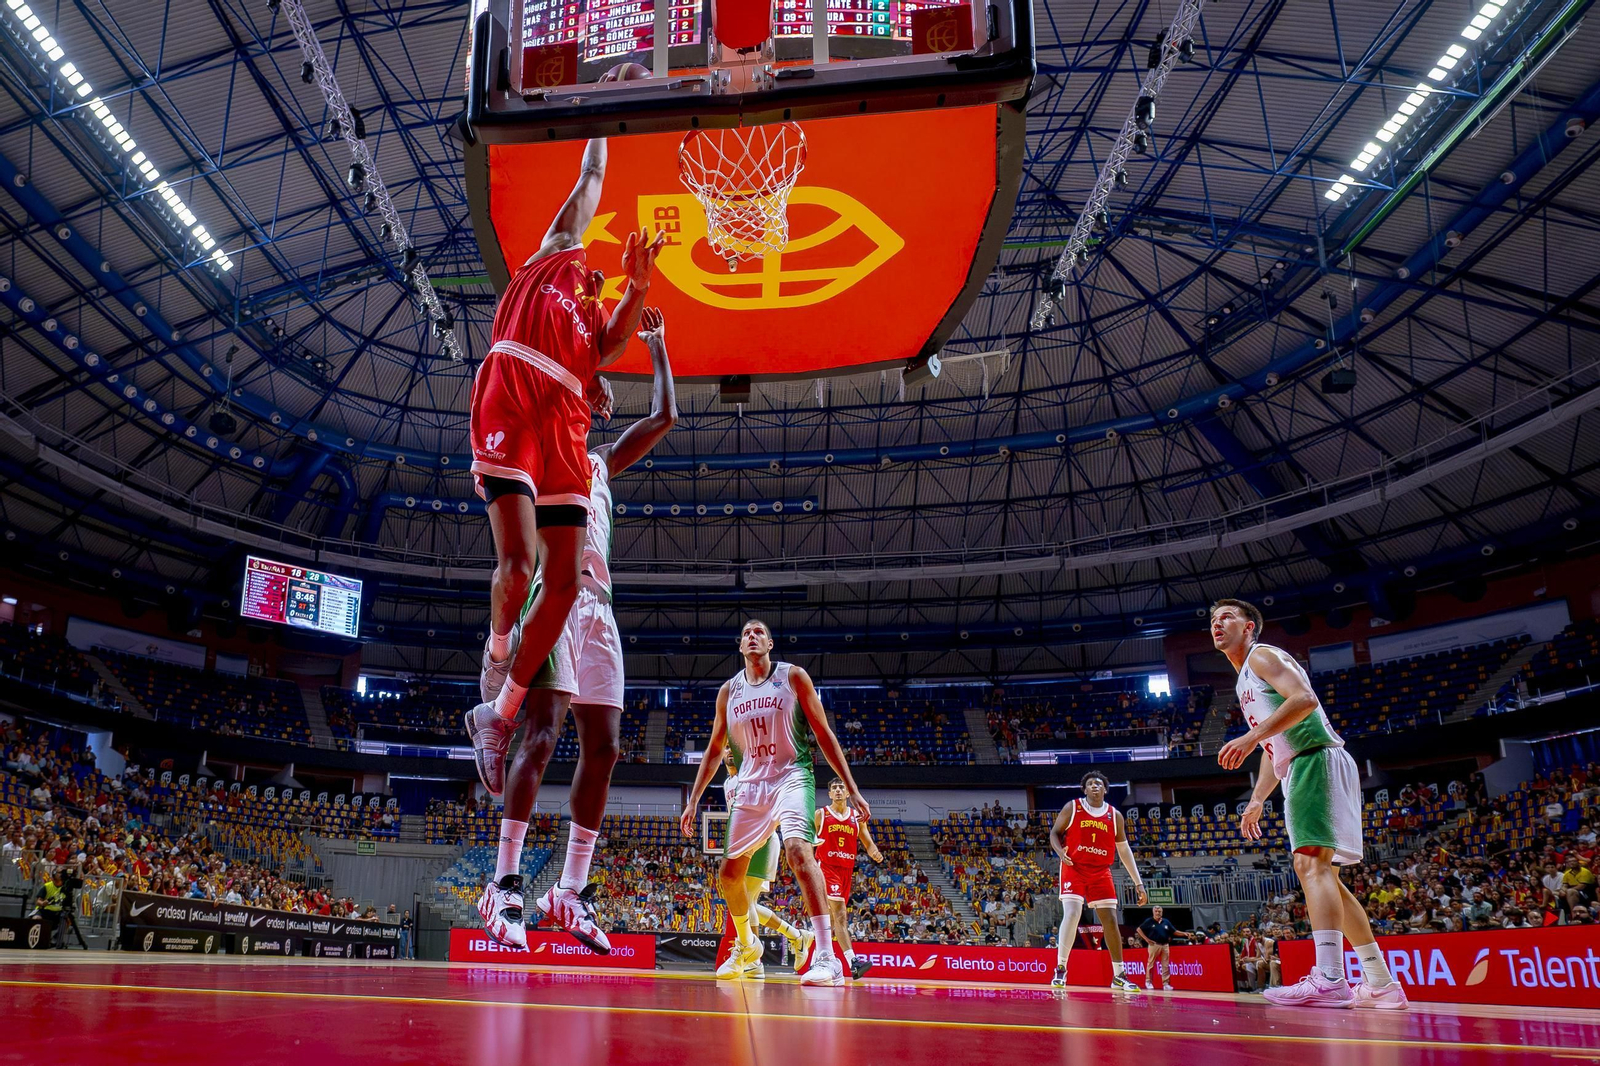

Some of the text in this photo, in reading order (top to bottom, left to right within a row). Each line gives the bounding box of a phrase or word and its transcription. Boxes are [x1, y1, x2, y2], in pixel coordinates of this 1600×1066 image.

[591, 12, 599, 20] 14
[590, 24, 598, 32] 15
[783, 26, 791, 34] 11
[590, 36, 598, 45] 16
[589, 49, 598, 58] 17
[654, 206, 682, 246] FEB
[291, 569, 302, 577] 18
[295, 591, 315, 602] 8:46
[734, 696, 783, 718] PORTUGAL
[750, 716, 767, 737] 14
[828, 824, 854, 836] ESPAÑA
[1080, 820, 1108, 832] ESPAÑA
[838, 837, 845, 847] 5
[1092, 833, 1096, 843] 1
[828, 850, 854, 860] endesa
[1077, 844, 1107, 856] endesa
[157, 906, 187, 920] endesa
[681, 938, 716, 947] endesa
[551, 943, 592, 955] Talento
[943, 956, 994, 971] Talento
[997, 961, 1006, 971] a
[1009, 958, 1047, 973] bordo
[1179, 963, 1183, 975] a
[1183, 960, 1203, 976] bordo
